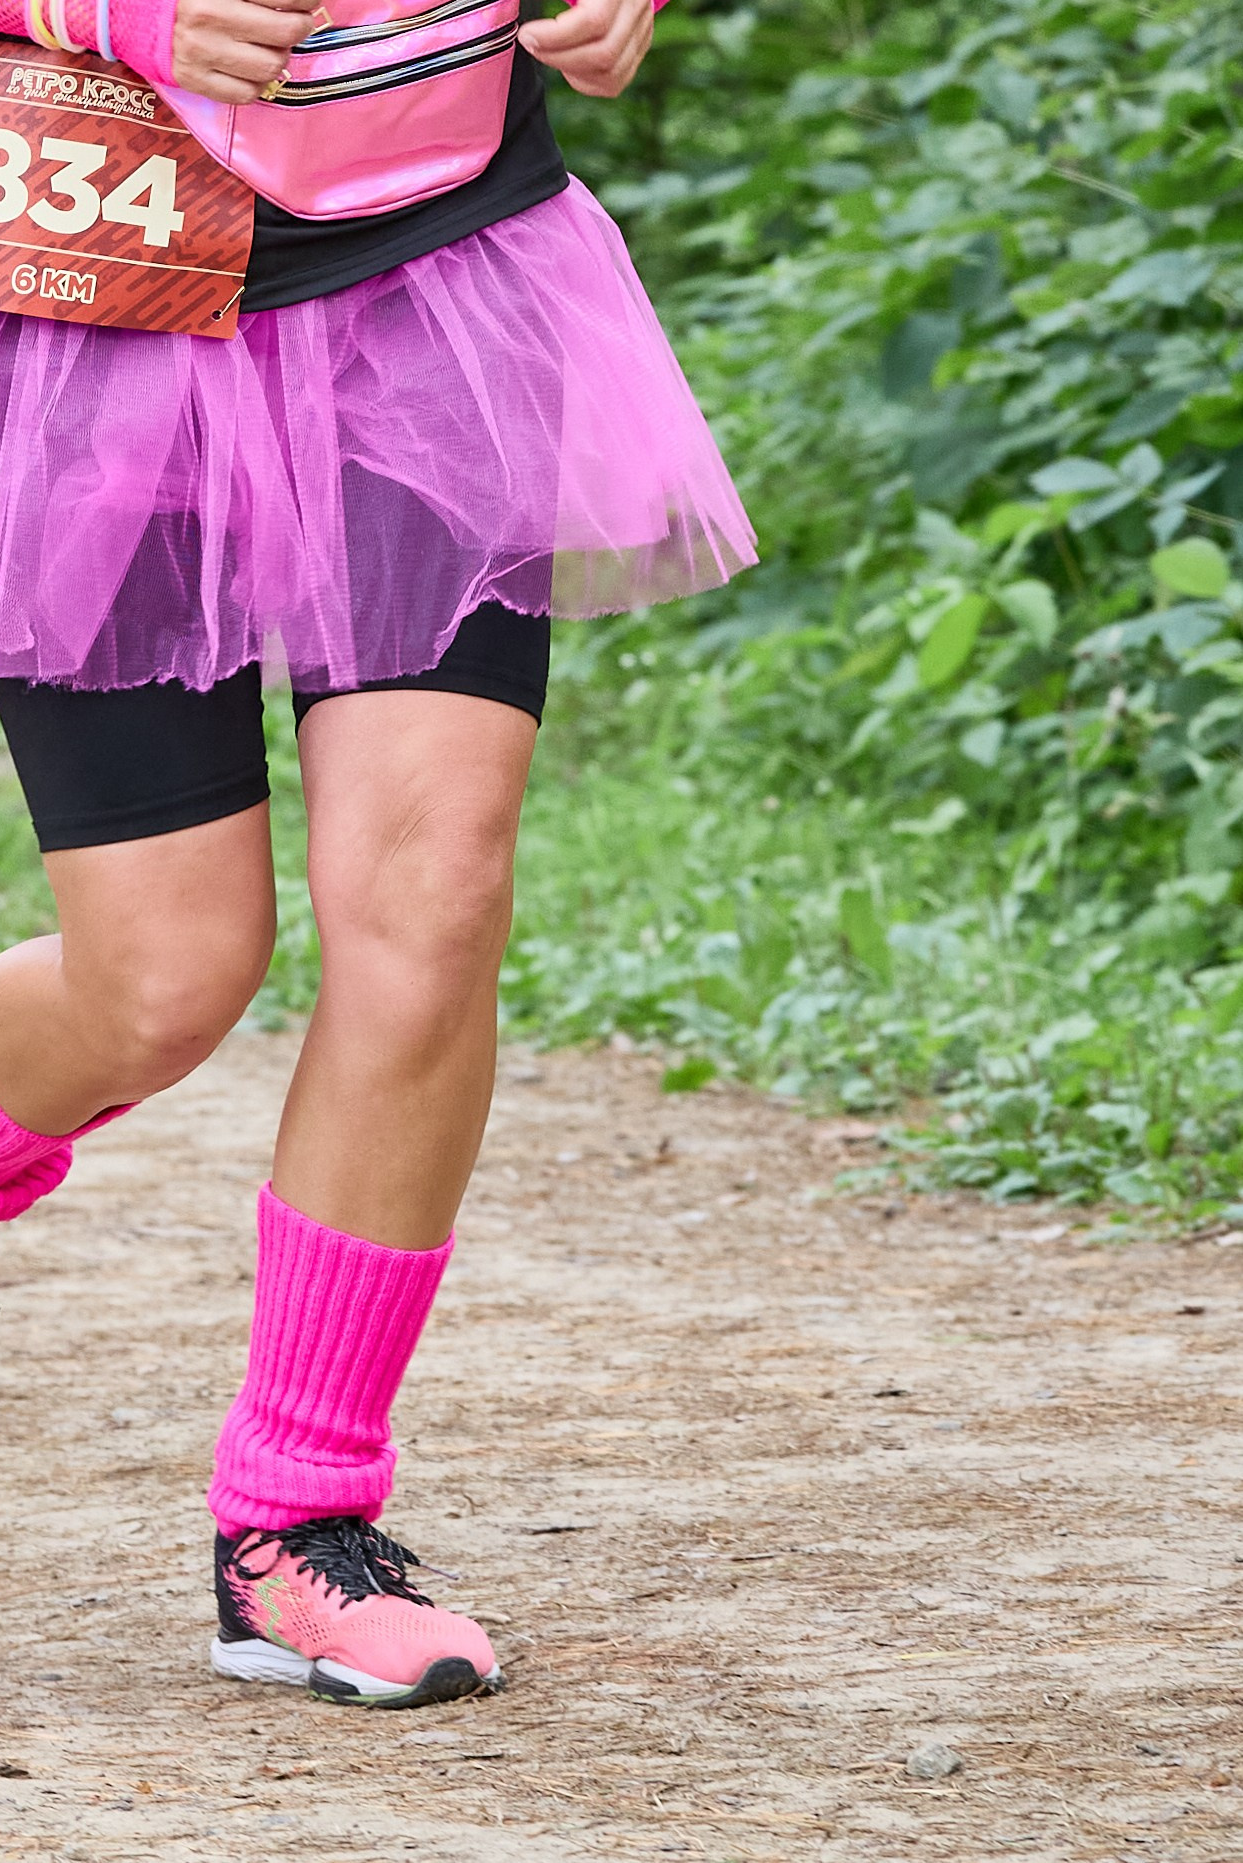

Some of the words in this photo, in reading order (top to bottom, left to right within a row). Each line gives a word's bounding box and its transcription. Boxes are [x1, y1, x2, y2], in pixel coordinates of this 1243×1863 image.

[10, 67, 78, 94] РЕТРО
[83, 78, 156, 112] КРОСС
[11, 263, 38, 295] 6
